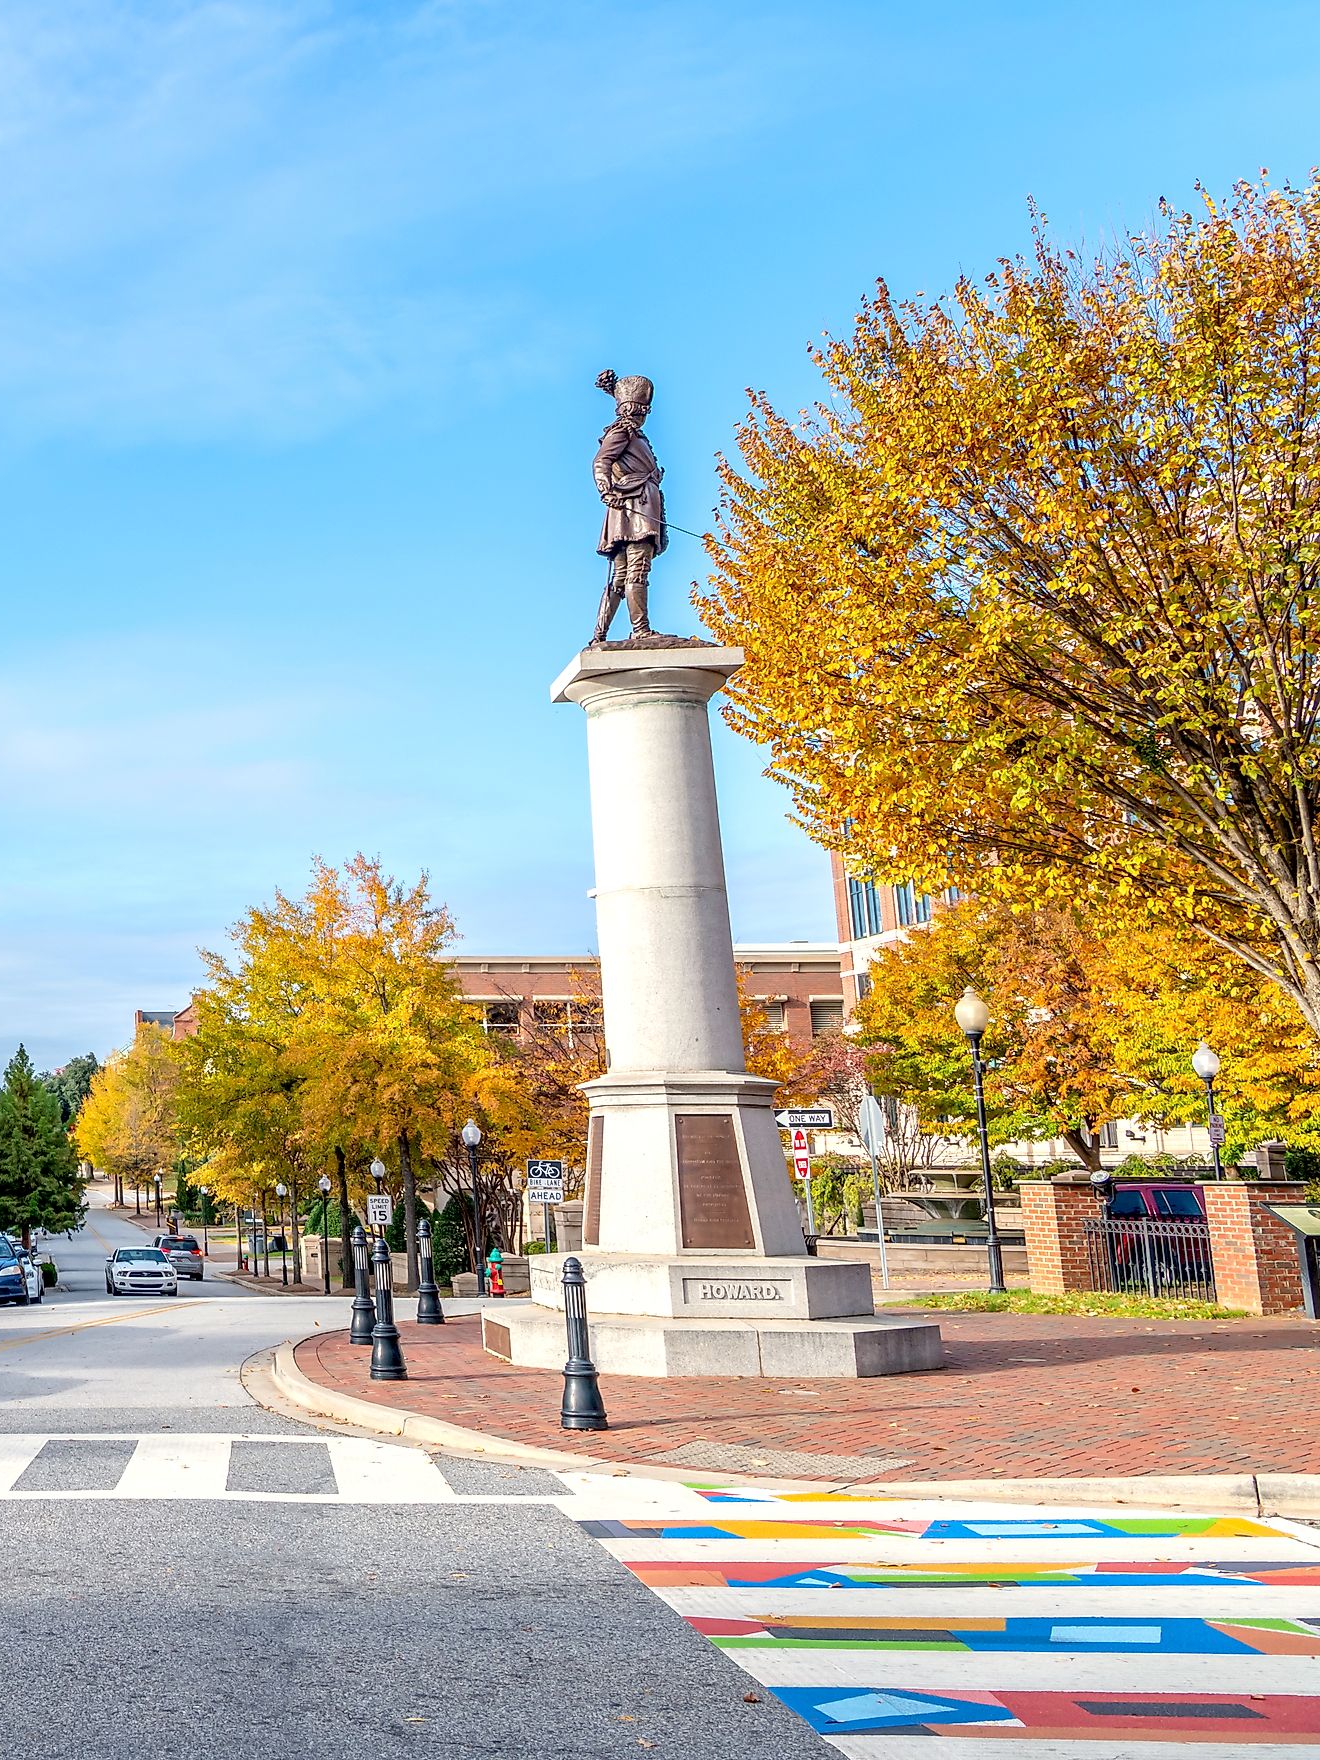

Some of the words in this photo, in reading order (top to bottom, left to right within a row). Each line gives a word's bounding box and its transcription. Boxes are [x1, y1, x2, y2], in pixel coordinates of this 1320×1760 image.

[789, 1114, 807, 1123] ONE
[808, 1114, 826, 1123] WAY
[546, 1179, 561, 1187] LANE
[530, 1191, 562, 1201] AHEAD
[372, 1210, 388, 1222] 15
